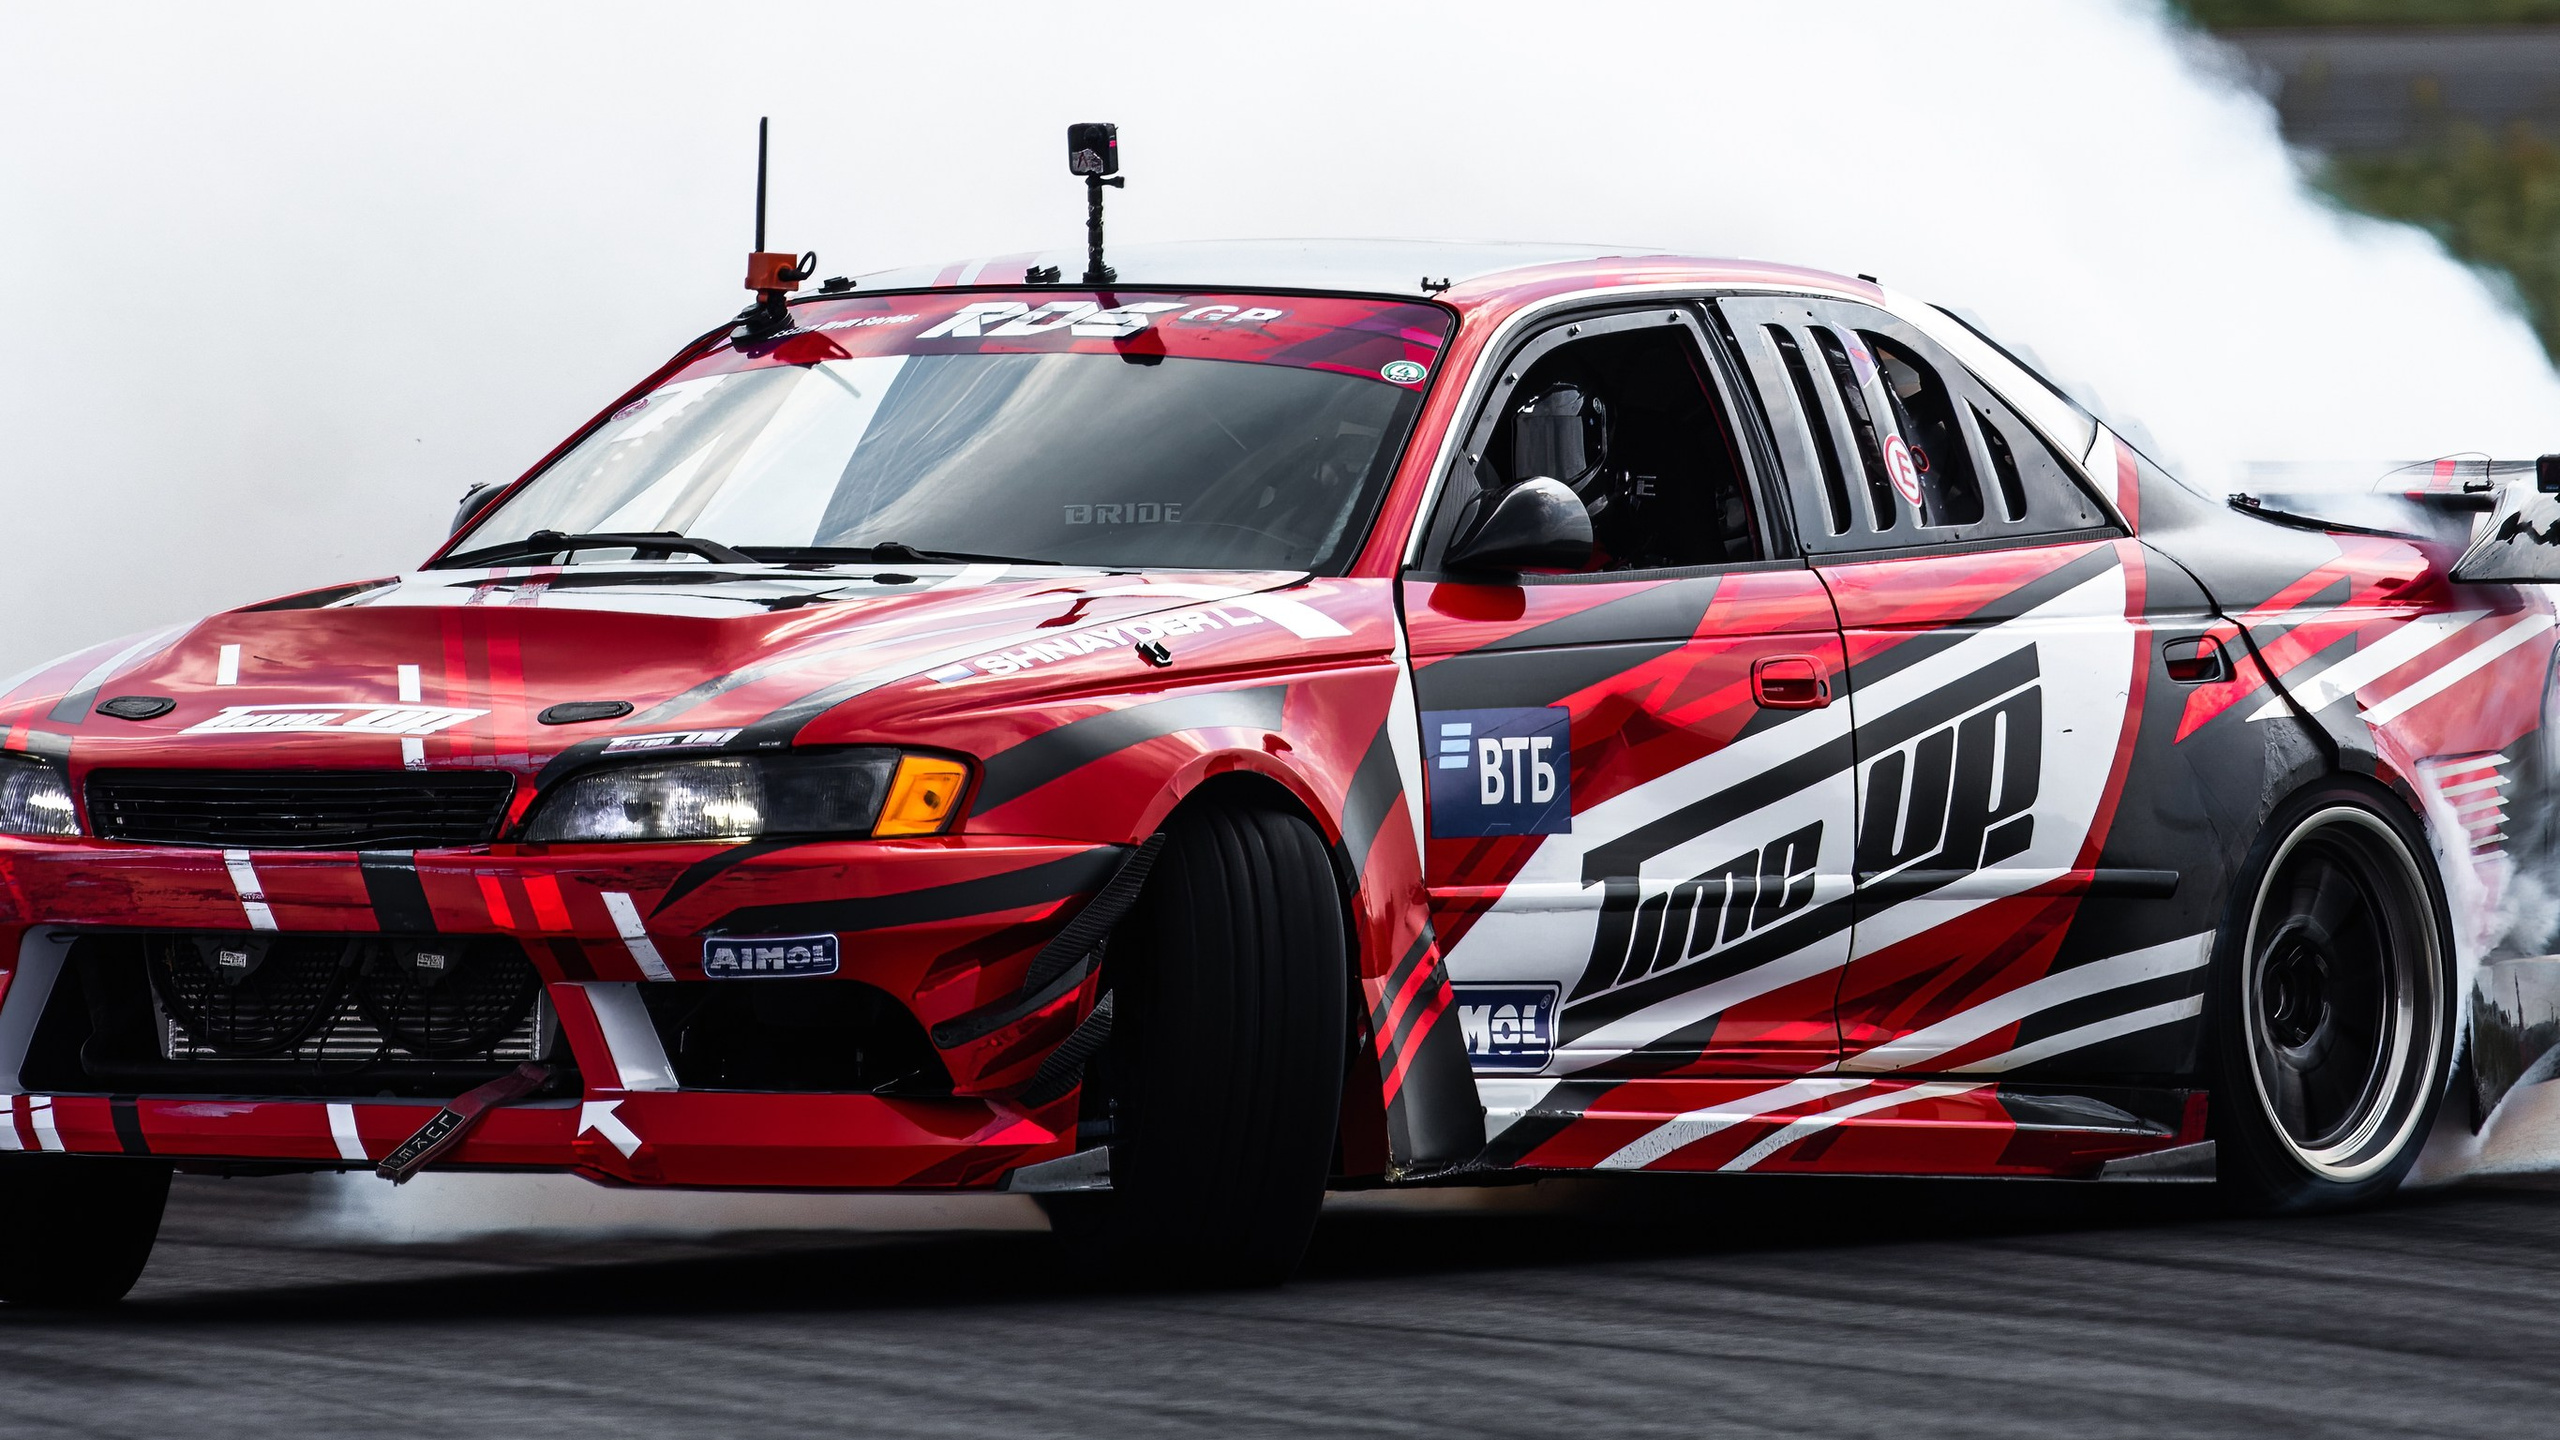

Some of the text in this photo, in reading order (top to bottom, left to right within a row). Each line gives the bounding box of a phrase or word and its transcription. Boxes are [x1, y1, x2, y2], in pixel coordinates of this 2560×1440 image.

[855, 313, 920, 327] Series
[916, 301, 1283, 338] RDS GP
[1895, 449, 1916, 490] E
[1063, 503, 1182, 524] BRIDE
[973, 610, 1226, 676] SHNAYDER
[1477, 736, 1556, 805] ВТБ
[710, 946, 832, 969] AIMOL
[1457, 1004, 1547, 1055] MOL
